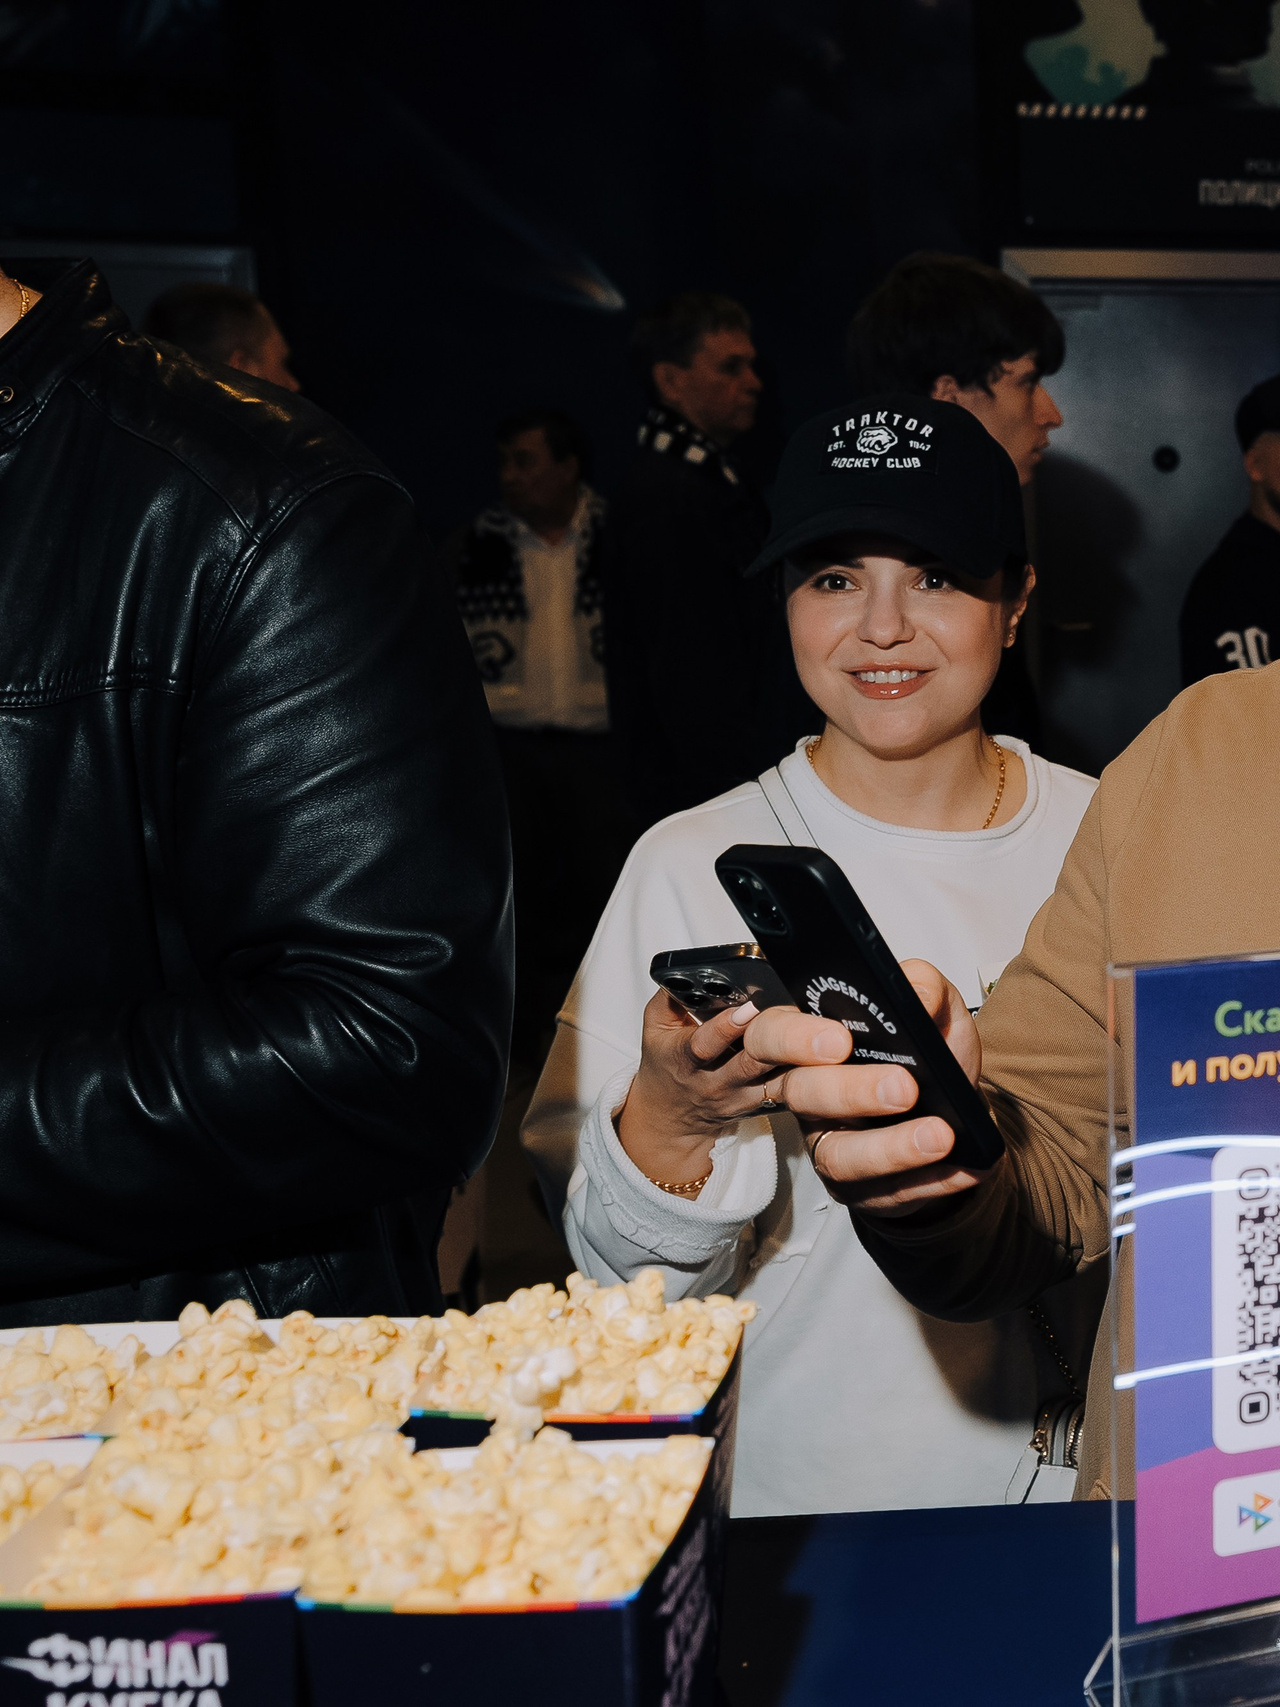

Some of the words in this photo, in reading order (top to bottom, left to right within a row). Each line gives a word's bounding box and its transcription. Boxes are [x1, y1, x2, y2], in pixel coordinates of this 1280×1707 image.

[832, 410, 934, 438] TRAKTOR
[827, 440, 847, 453] EST.
[831, 456, 880, 469] HOCKEY
[886, 456, 922, 469] CLUB
[1214, 625, 1275, 668] 30
[811, 976, 898, 1035] LAGERFELD
[841, 1018, 870, 1033] PARIS
[1171, 1058, 1197, 1087] и
[14, 1632, 229, 1689] ФИНАЛ
